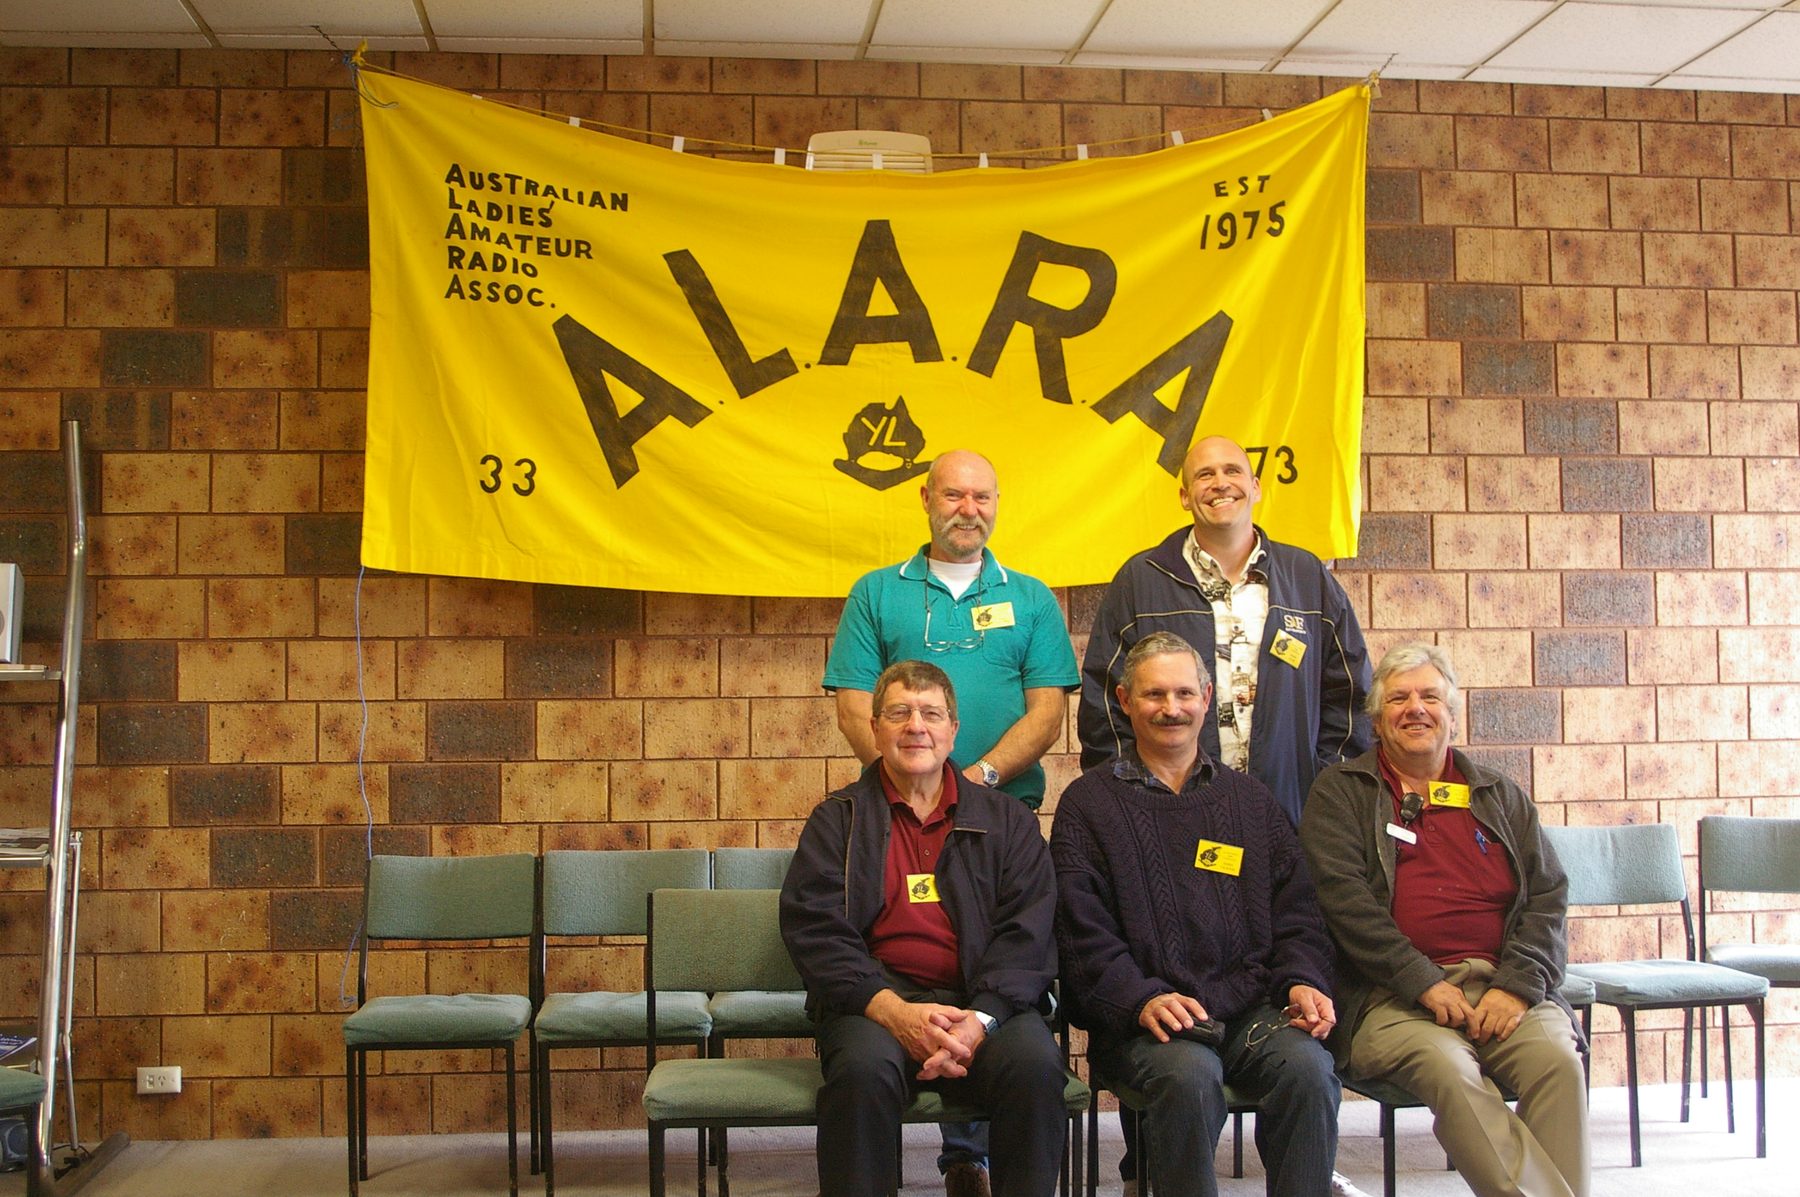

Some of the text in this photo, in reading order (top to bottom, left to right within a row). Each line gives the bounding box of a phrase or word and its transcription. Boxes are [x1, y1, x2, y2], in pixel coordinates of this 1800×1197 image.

[445, 163, 629, 212] AUSTRALIAN
[1213, 174, 1271, 198] EST
[445, 212, 594, 260] AMATEUR
[1200, 200, 1286, 250] 1975
[447, 245, 539, 278] RADIO
[444, 273, 556, 308] ASSOC.
[861, 415, 907, 446] YL
[479, 454, 537, 497] 33
[1244, 446, 1298, 485] 73
